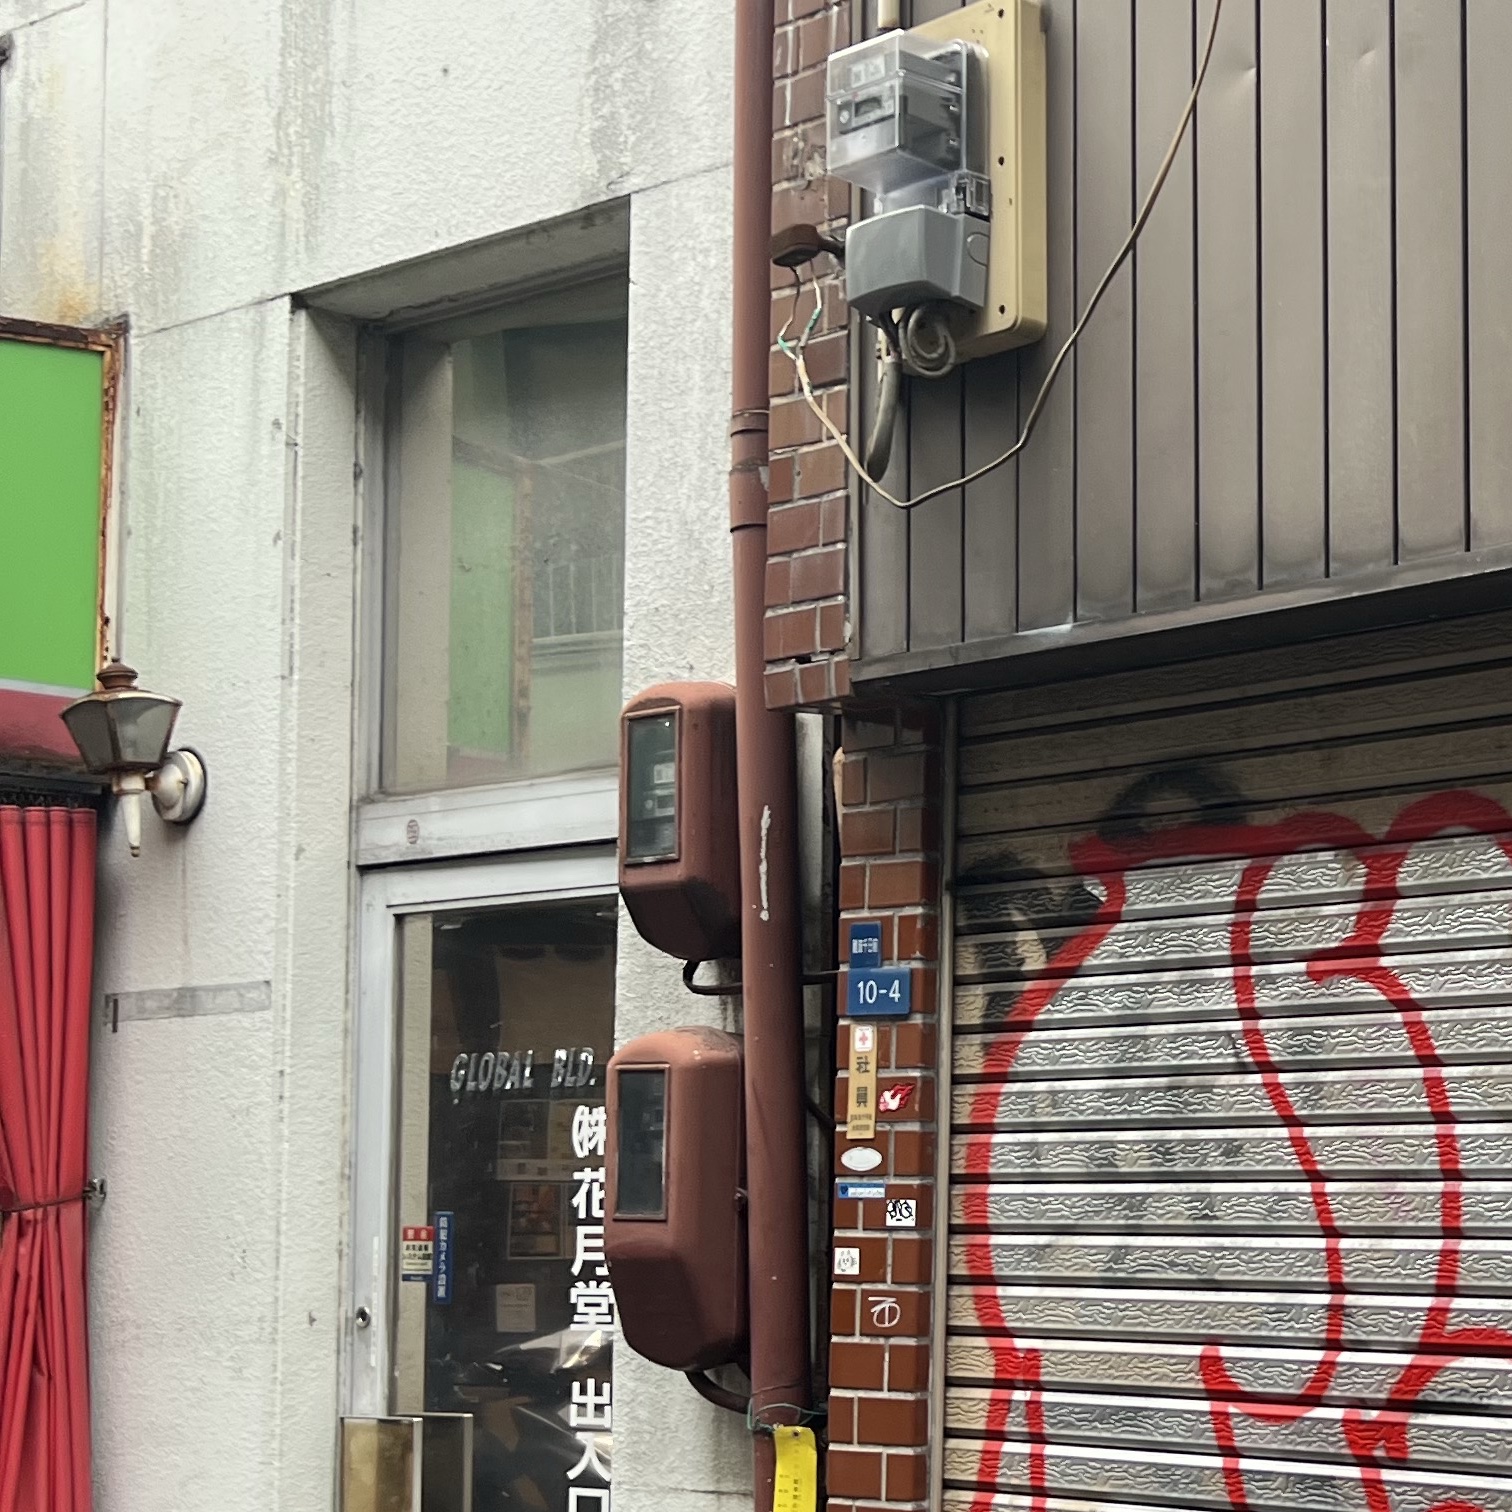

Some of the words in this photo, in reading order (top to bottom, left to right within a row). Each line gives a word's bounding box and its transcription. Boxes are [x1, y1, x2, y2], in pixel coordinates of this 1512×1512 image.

[857, 979, 901, 1004] 10-4
[450, 1049, 534, 1093] GLOBAL
[551, 1046, 596, 1088] BLD.
